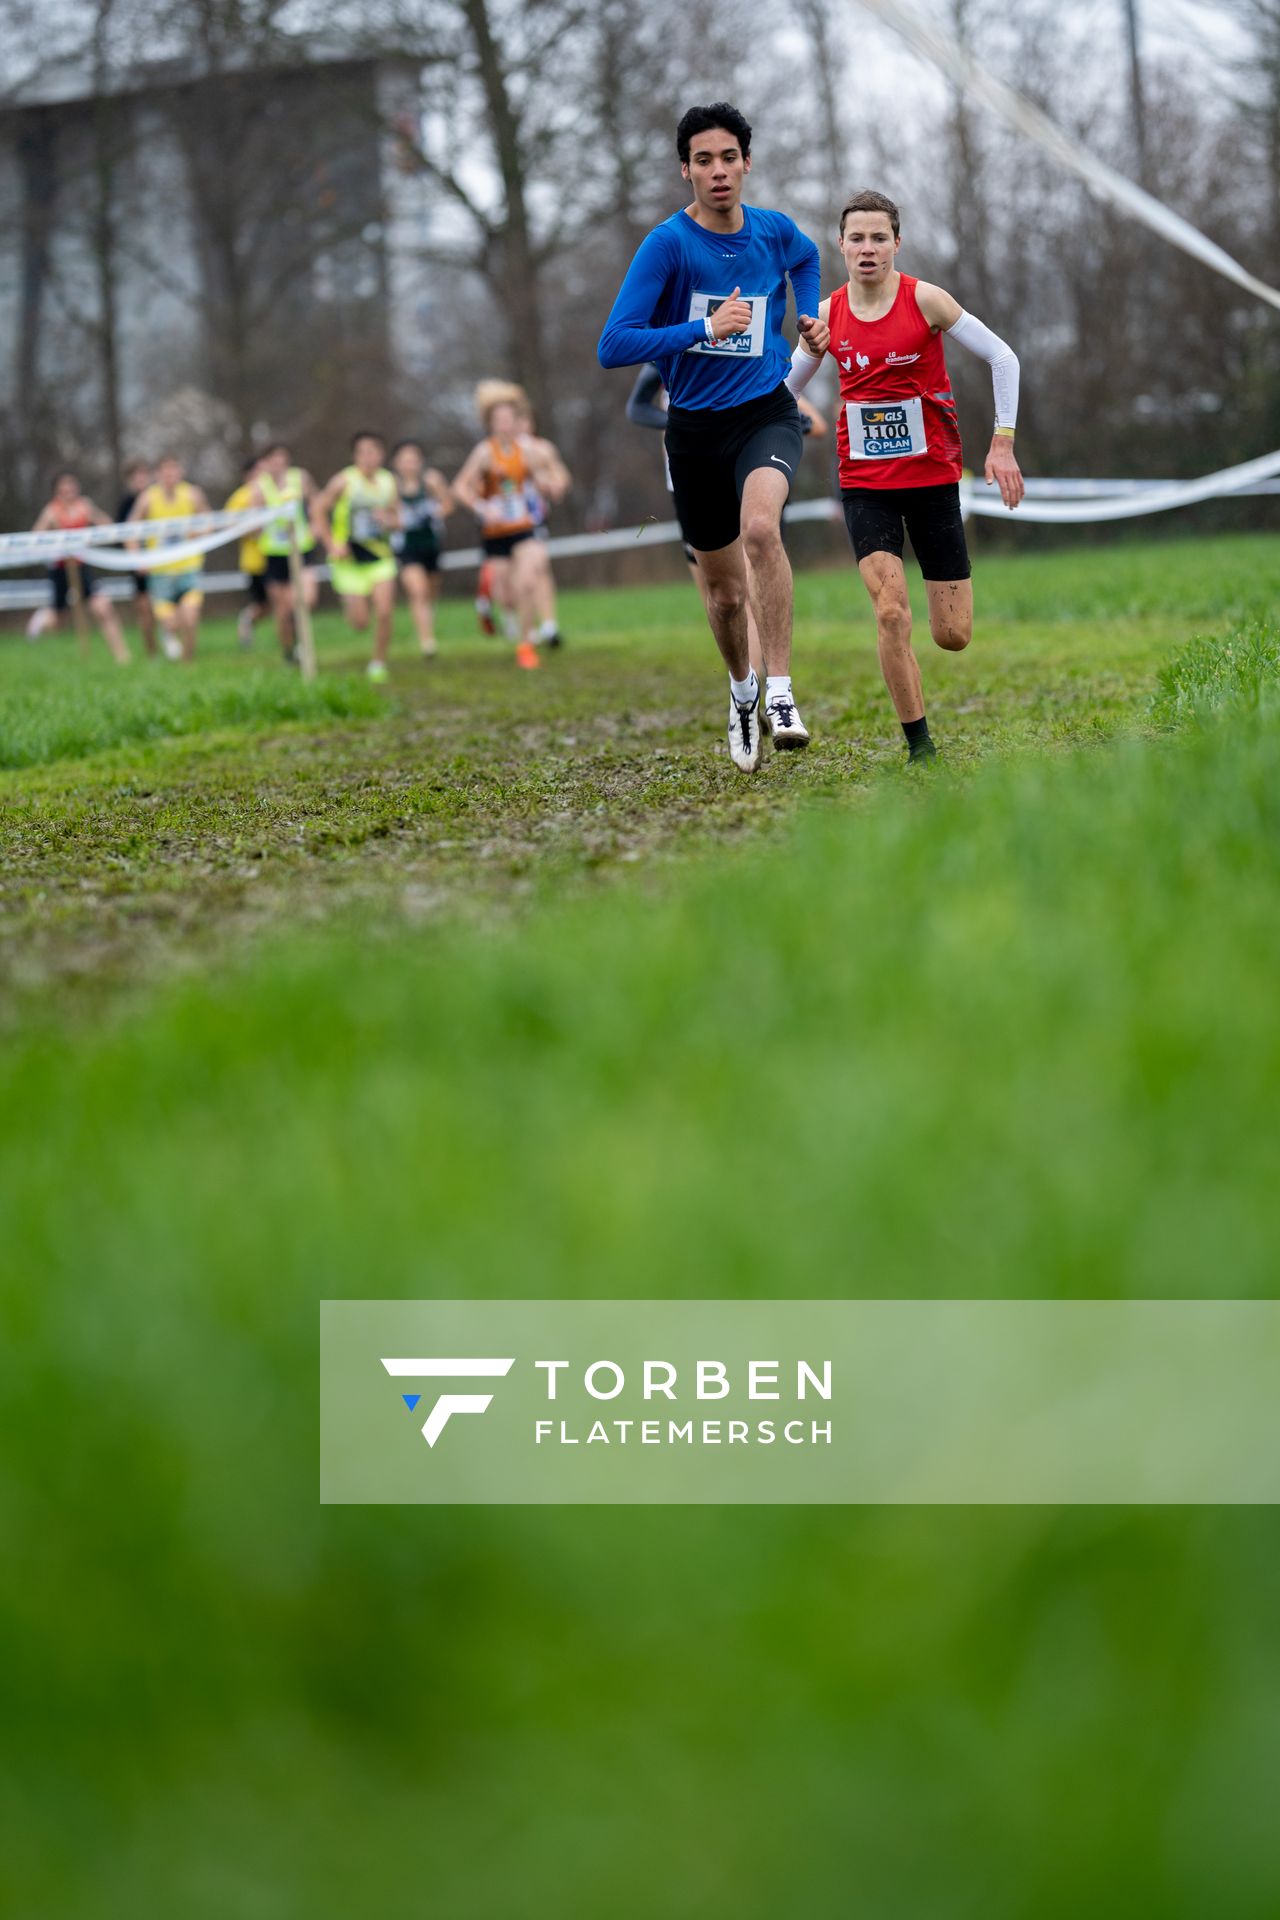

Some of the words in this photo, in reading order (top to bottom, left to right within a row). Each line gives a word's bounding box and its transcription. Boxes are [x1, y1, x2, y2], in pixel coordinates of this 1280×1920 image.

[885, 411, 903, 422] GLS
[863, 424, 909, 439] 1100
[883, 439, 910, 449] PLAN
